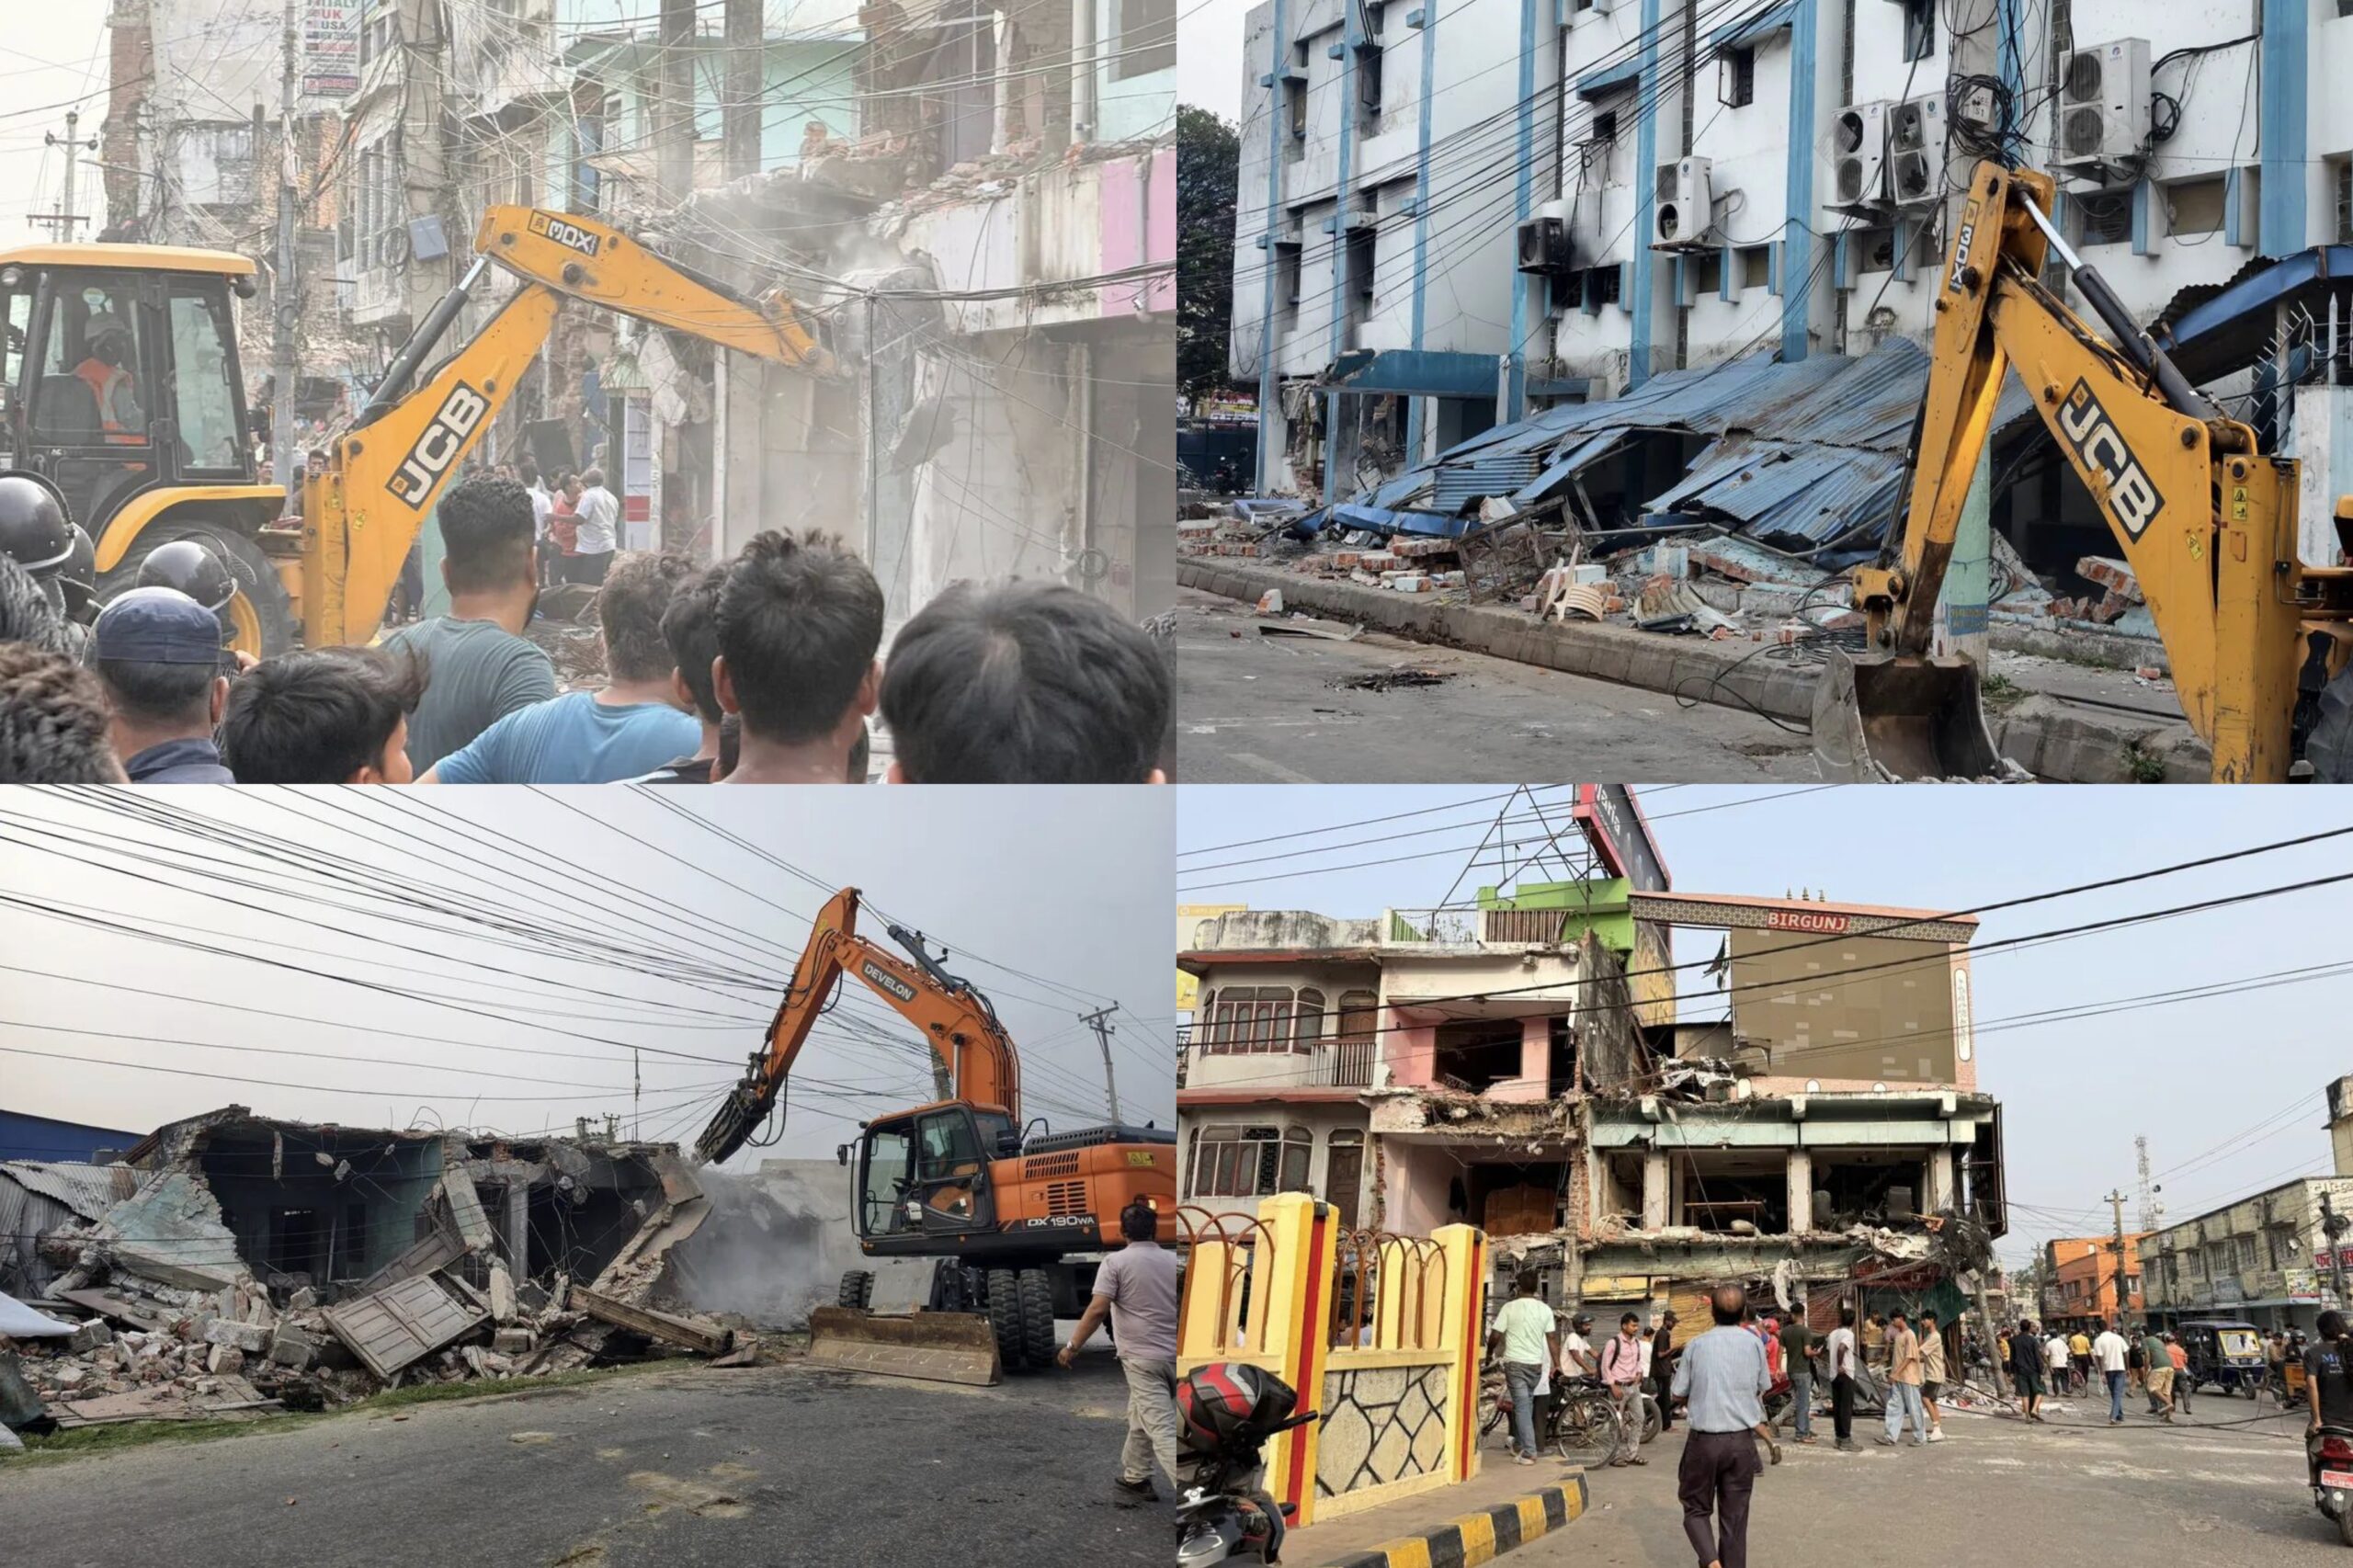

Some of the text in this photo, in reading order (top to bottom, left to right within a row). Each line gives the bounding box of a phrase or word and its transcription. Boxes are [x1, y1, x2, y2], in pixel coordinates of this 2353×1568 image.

[321, 20, 347, 30] USA
[322, 9, 343, 19] UK
[548, 221, 594, 254] 3DX
[1950, 225, 1973, 284] 3DX
[403, 387, 485, 504] JCB
[2061, 402, 2156, 533] JCB
[1768, 912, 1846, 931] BIRGUNJ
[864, 963, 913, 1001] DEVELON
